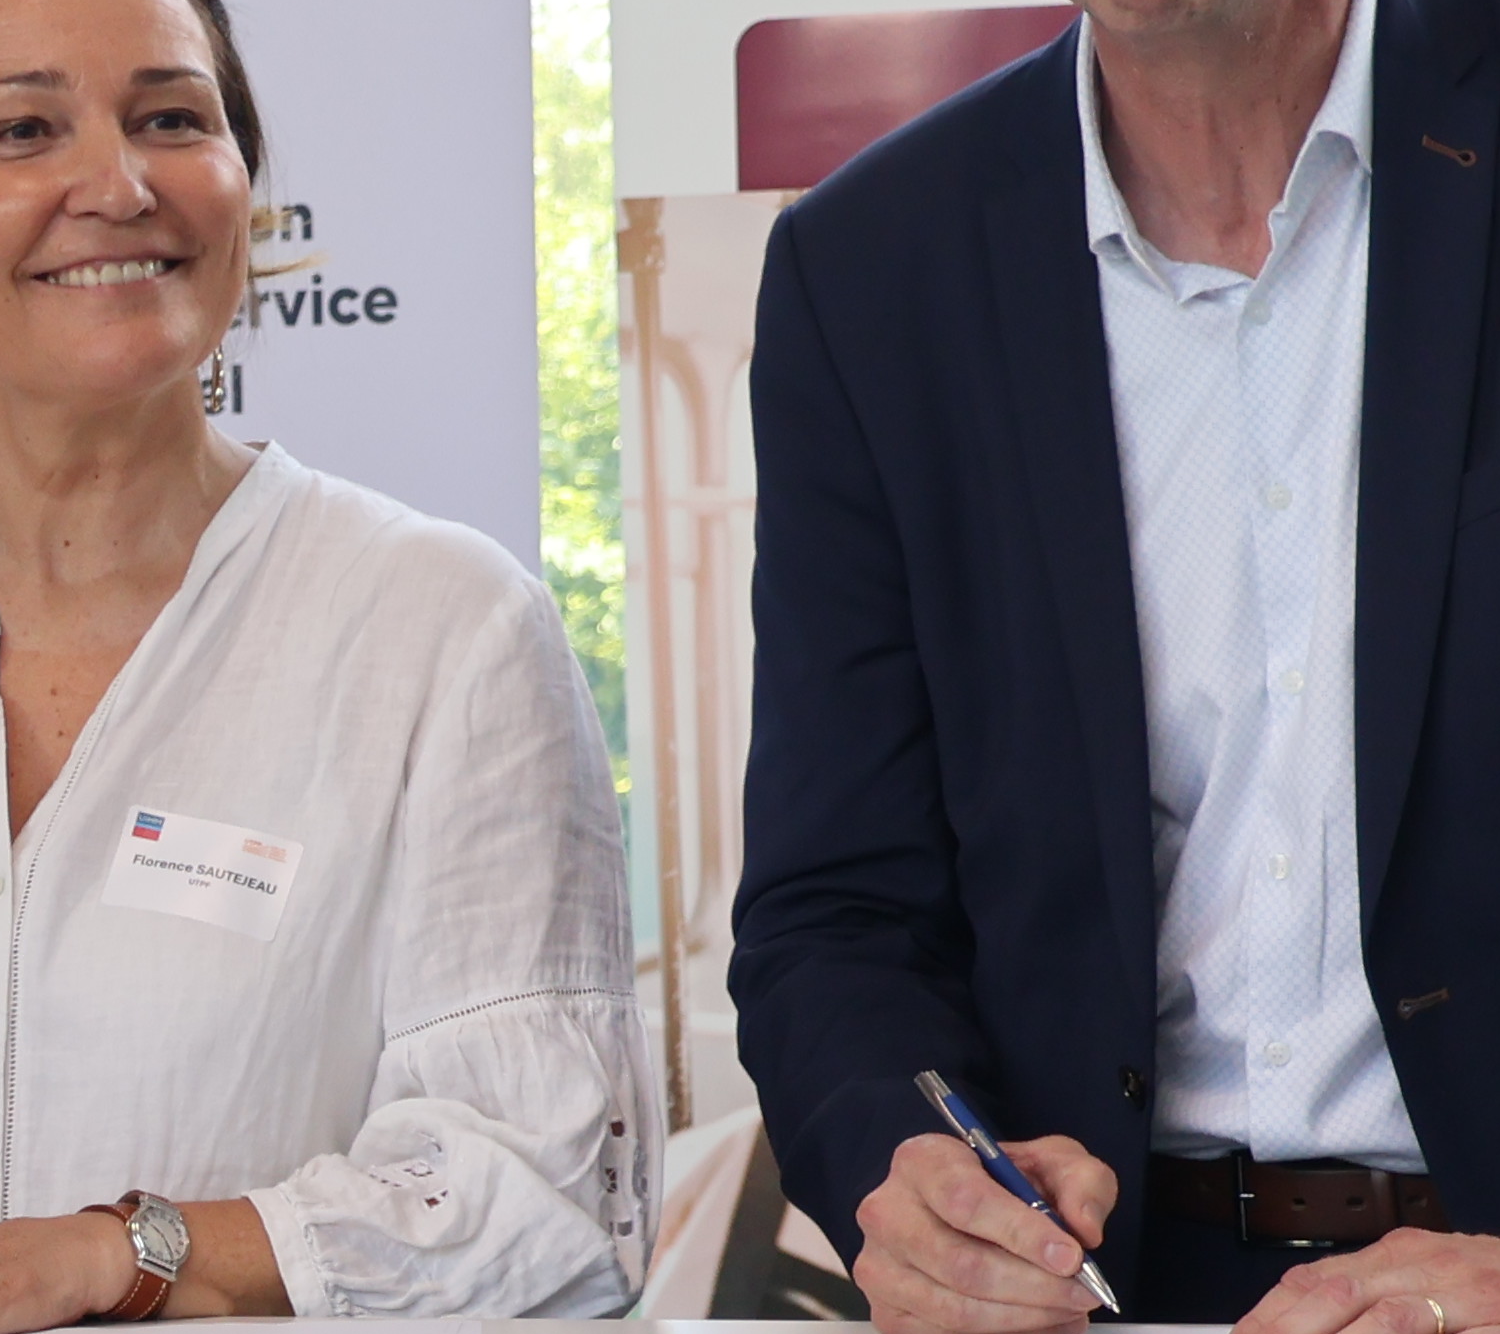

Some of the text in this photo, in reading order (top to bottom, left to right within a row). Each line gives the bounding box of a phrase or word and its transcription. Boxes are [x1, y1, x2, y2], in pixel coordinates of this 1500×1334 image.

[230, 273, 398, 330] rvice
[132, 853, 278, 896] Florence SAUTEJEAU
